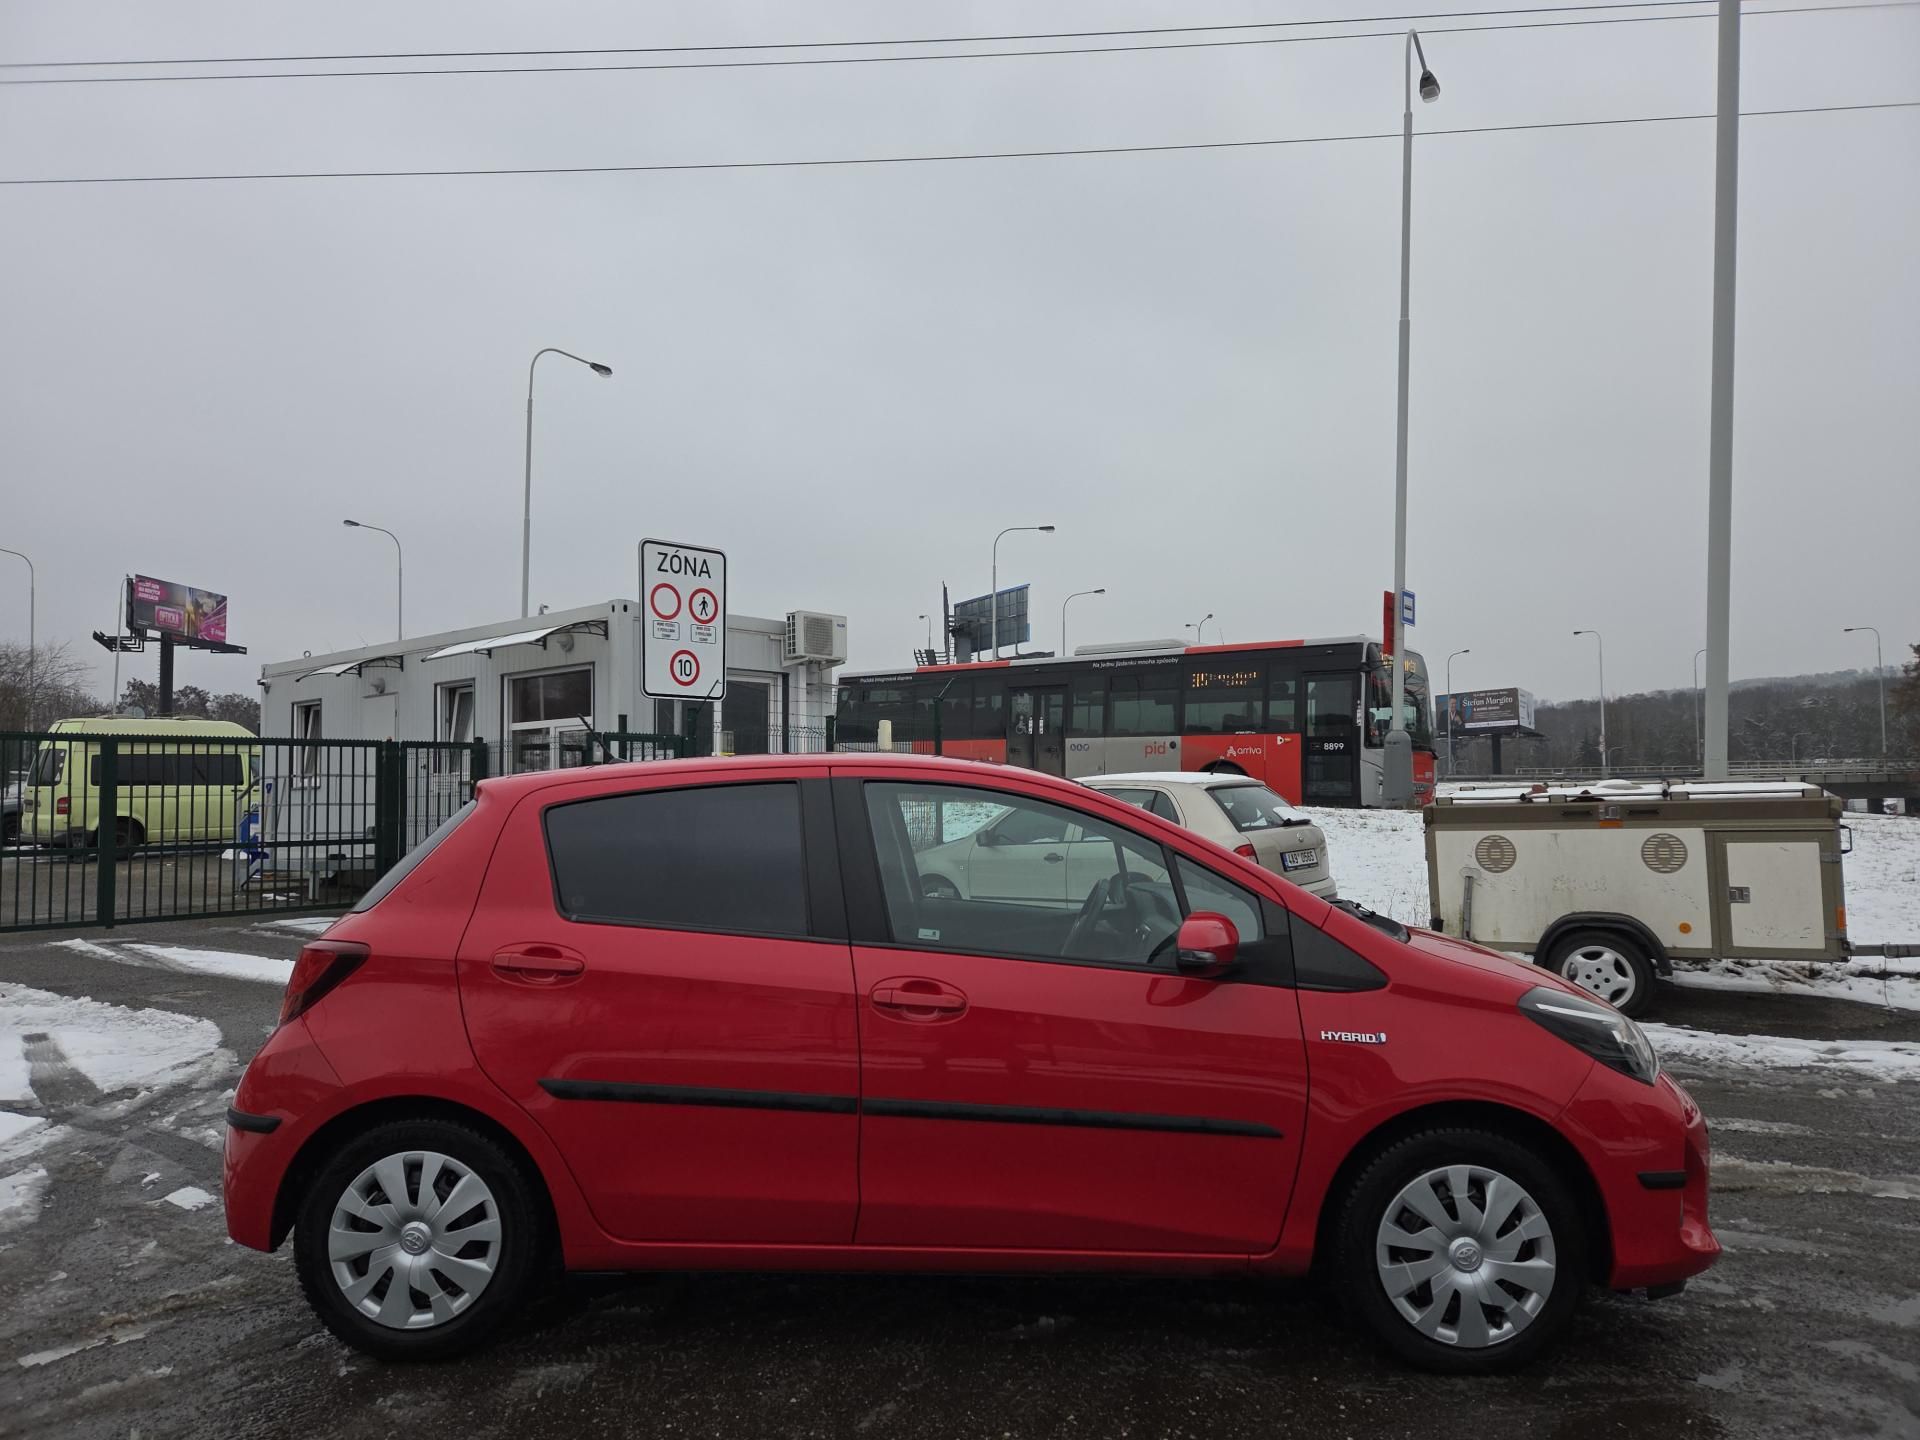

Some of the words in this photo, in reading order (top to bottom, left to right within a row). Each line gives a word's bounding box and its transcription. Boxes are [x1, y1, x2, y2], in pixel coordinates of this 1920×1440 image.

[657, 550, 712, 579] ZÓNA
[678, 658, 692, 677] 10
[1144, 741, 1166, 758] pid
[1237, 746, 1262, 755] arriva
[1323, 742, 1345, 751] 8899
[1320, 1030, 1377, 1043] HYBRID
